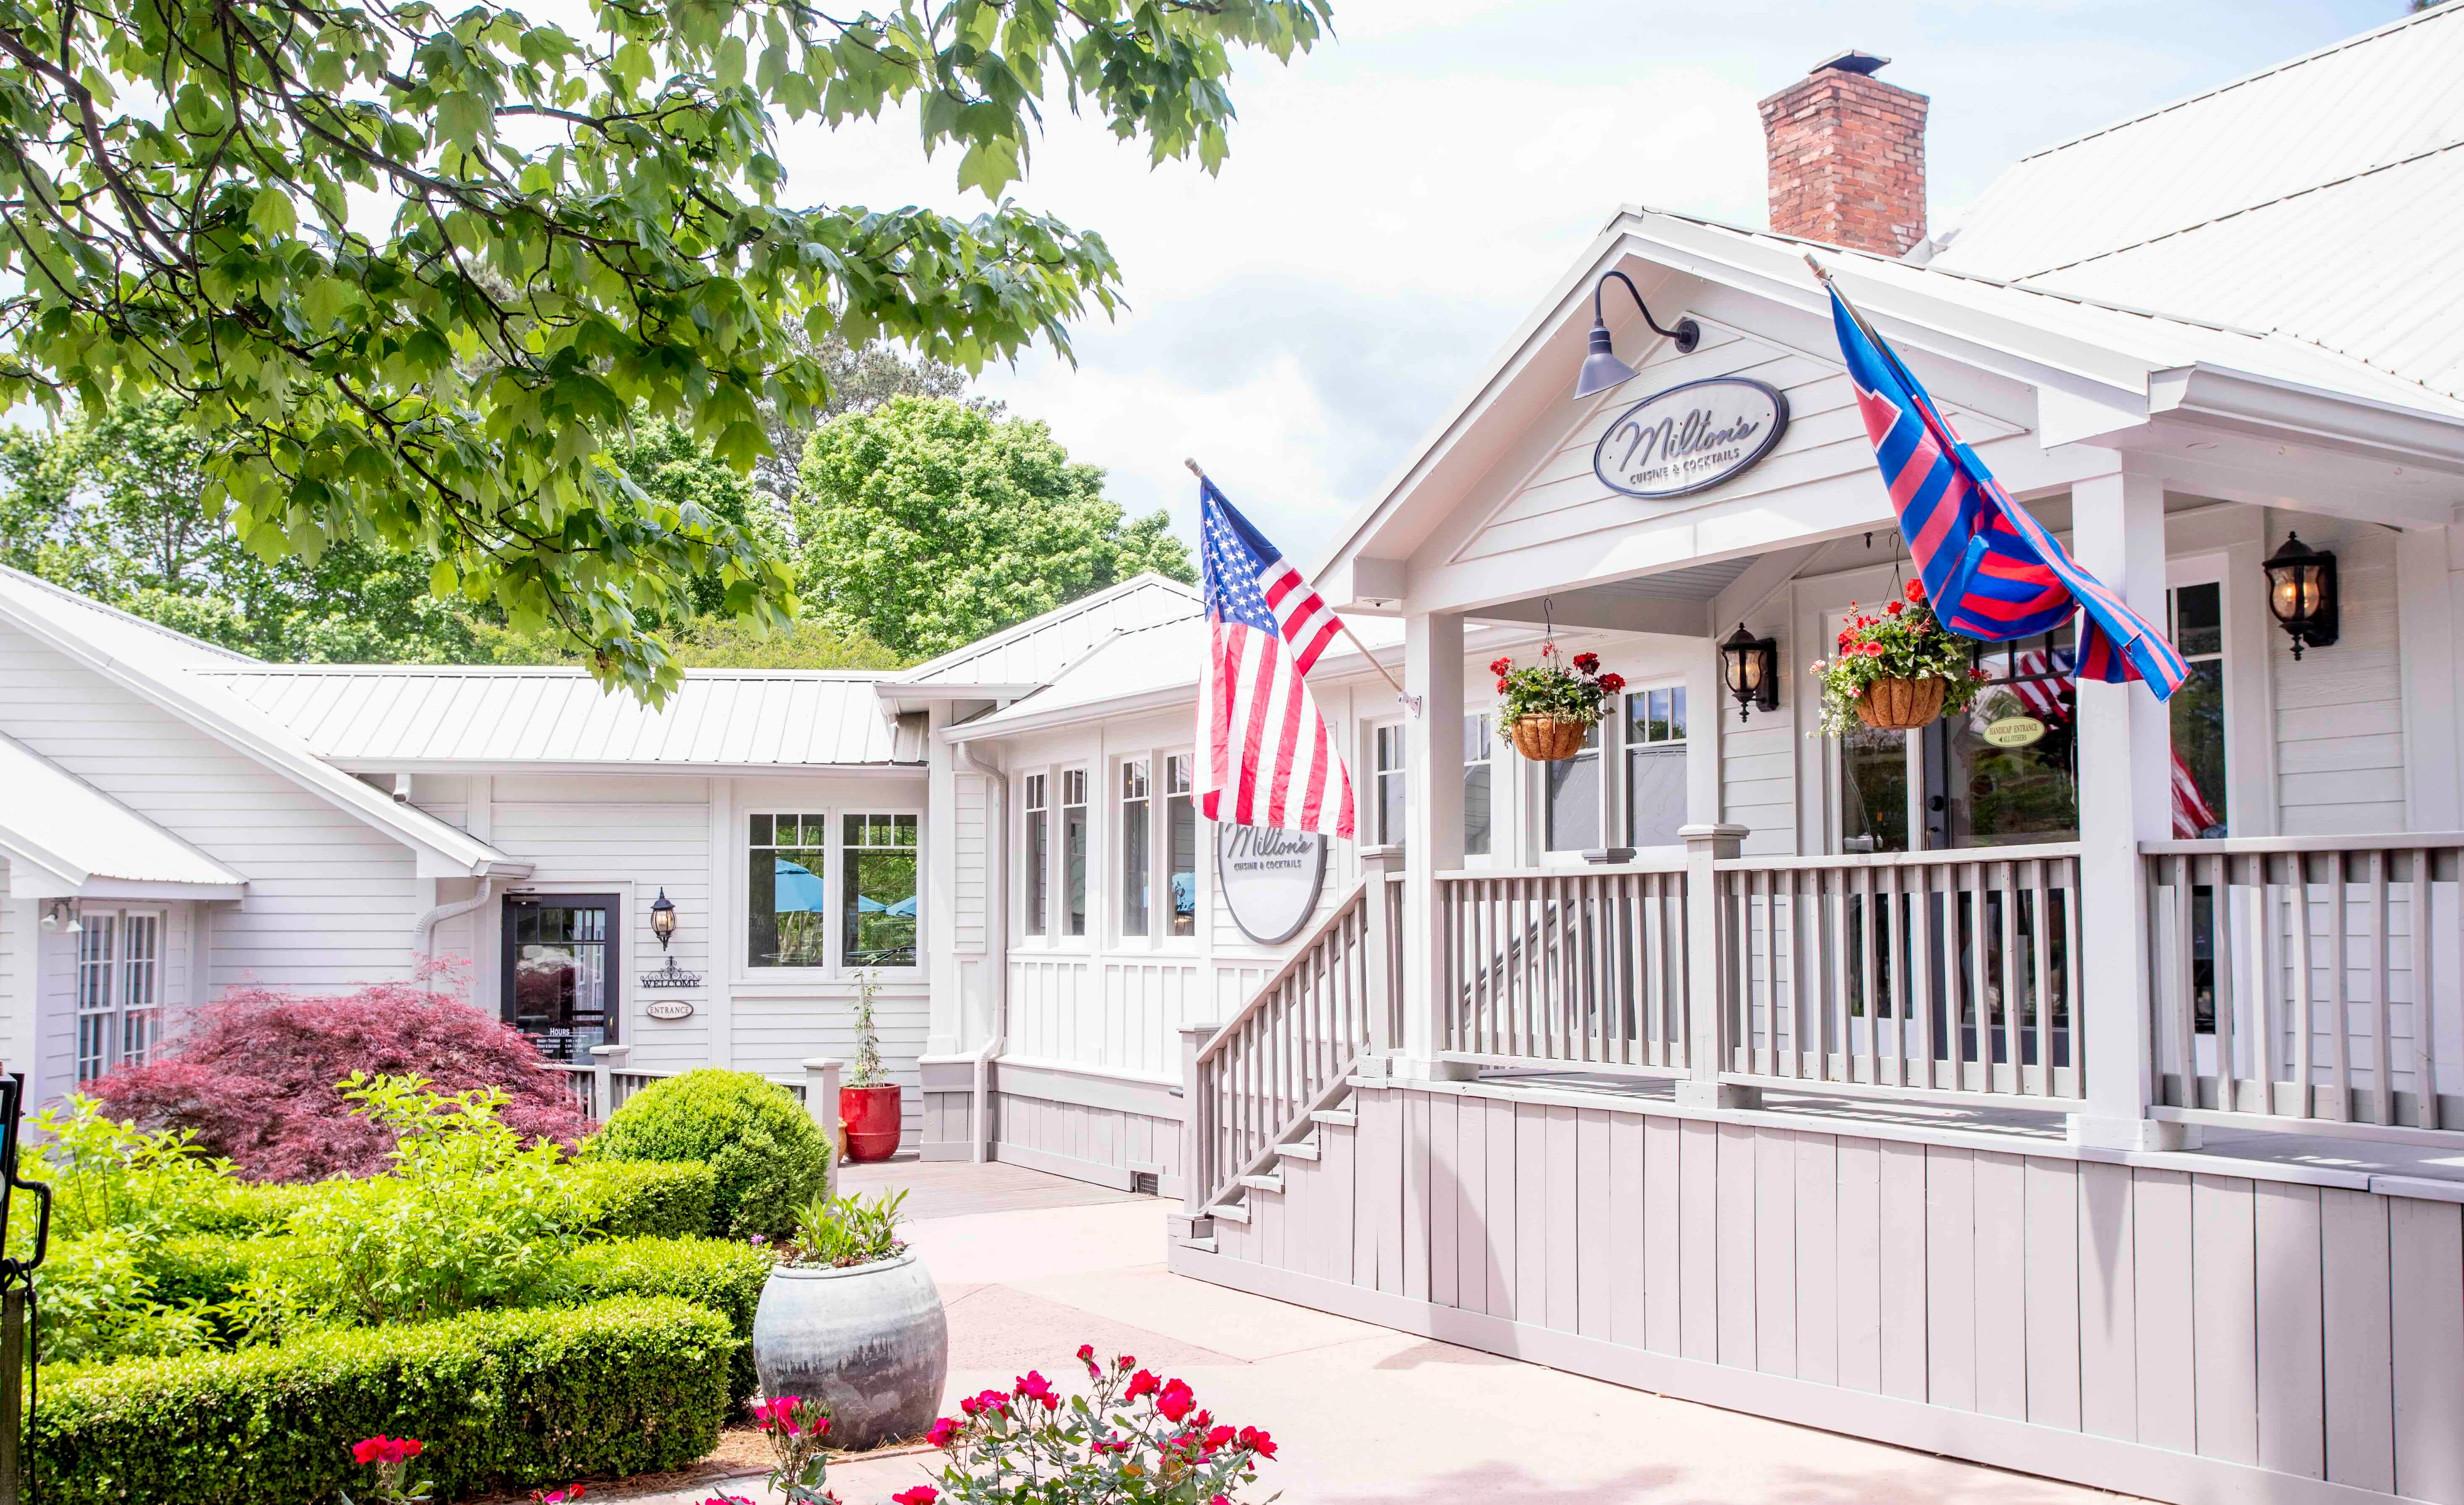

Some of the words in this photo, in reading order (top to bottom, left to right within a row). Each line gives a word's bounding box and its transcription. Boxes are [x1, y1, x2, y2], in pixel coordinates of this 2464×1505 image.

[1615, 409, 1759, 472] Milton's
[1630, 467, 1669, 485] CUISINE
[1672, 464, 1680, 474] &
[1683, 448, 1740, 471] COCKTAILS
[1989, 726, 2012, 735] HANDICAP
[2014, 723, 2038, 733] ENTRANCE
[1225, 823, 1314, 858] Milton's
[1234, 861, 1258, 871] CUISINE
[1259, 861, 1265, 869] &
[1266, 859, 1302, 869] COCKTAILS
